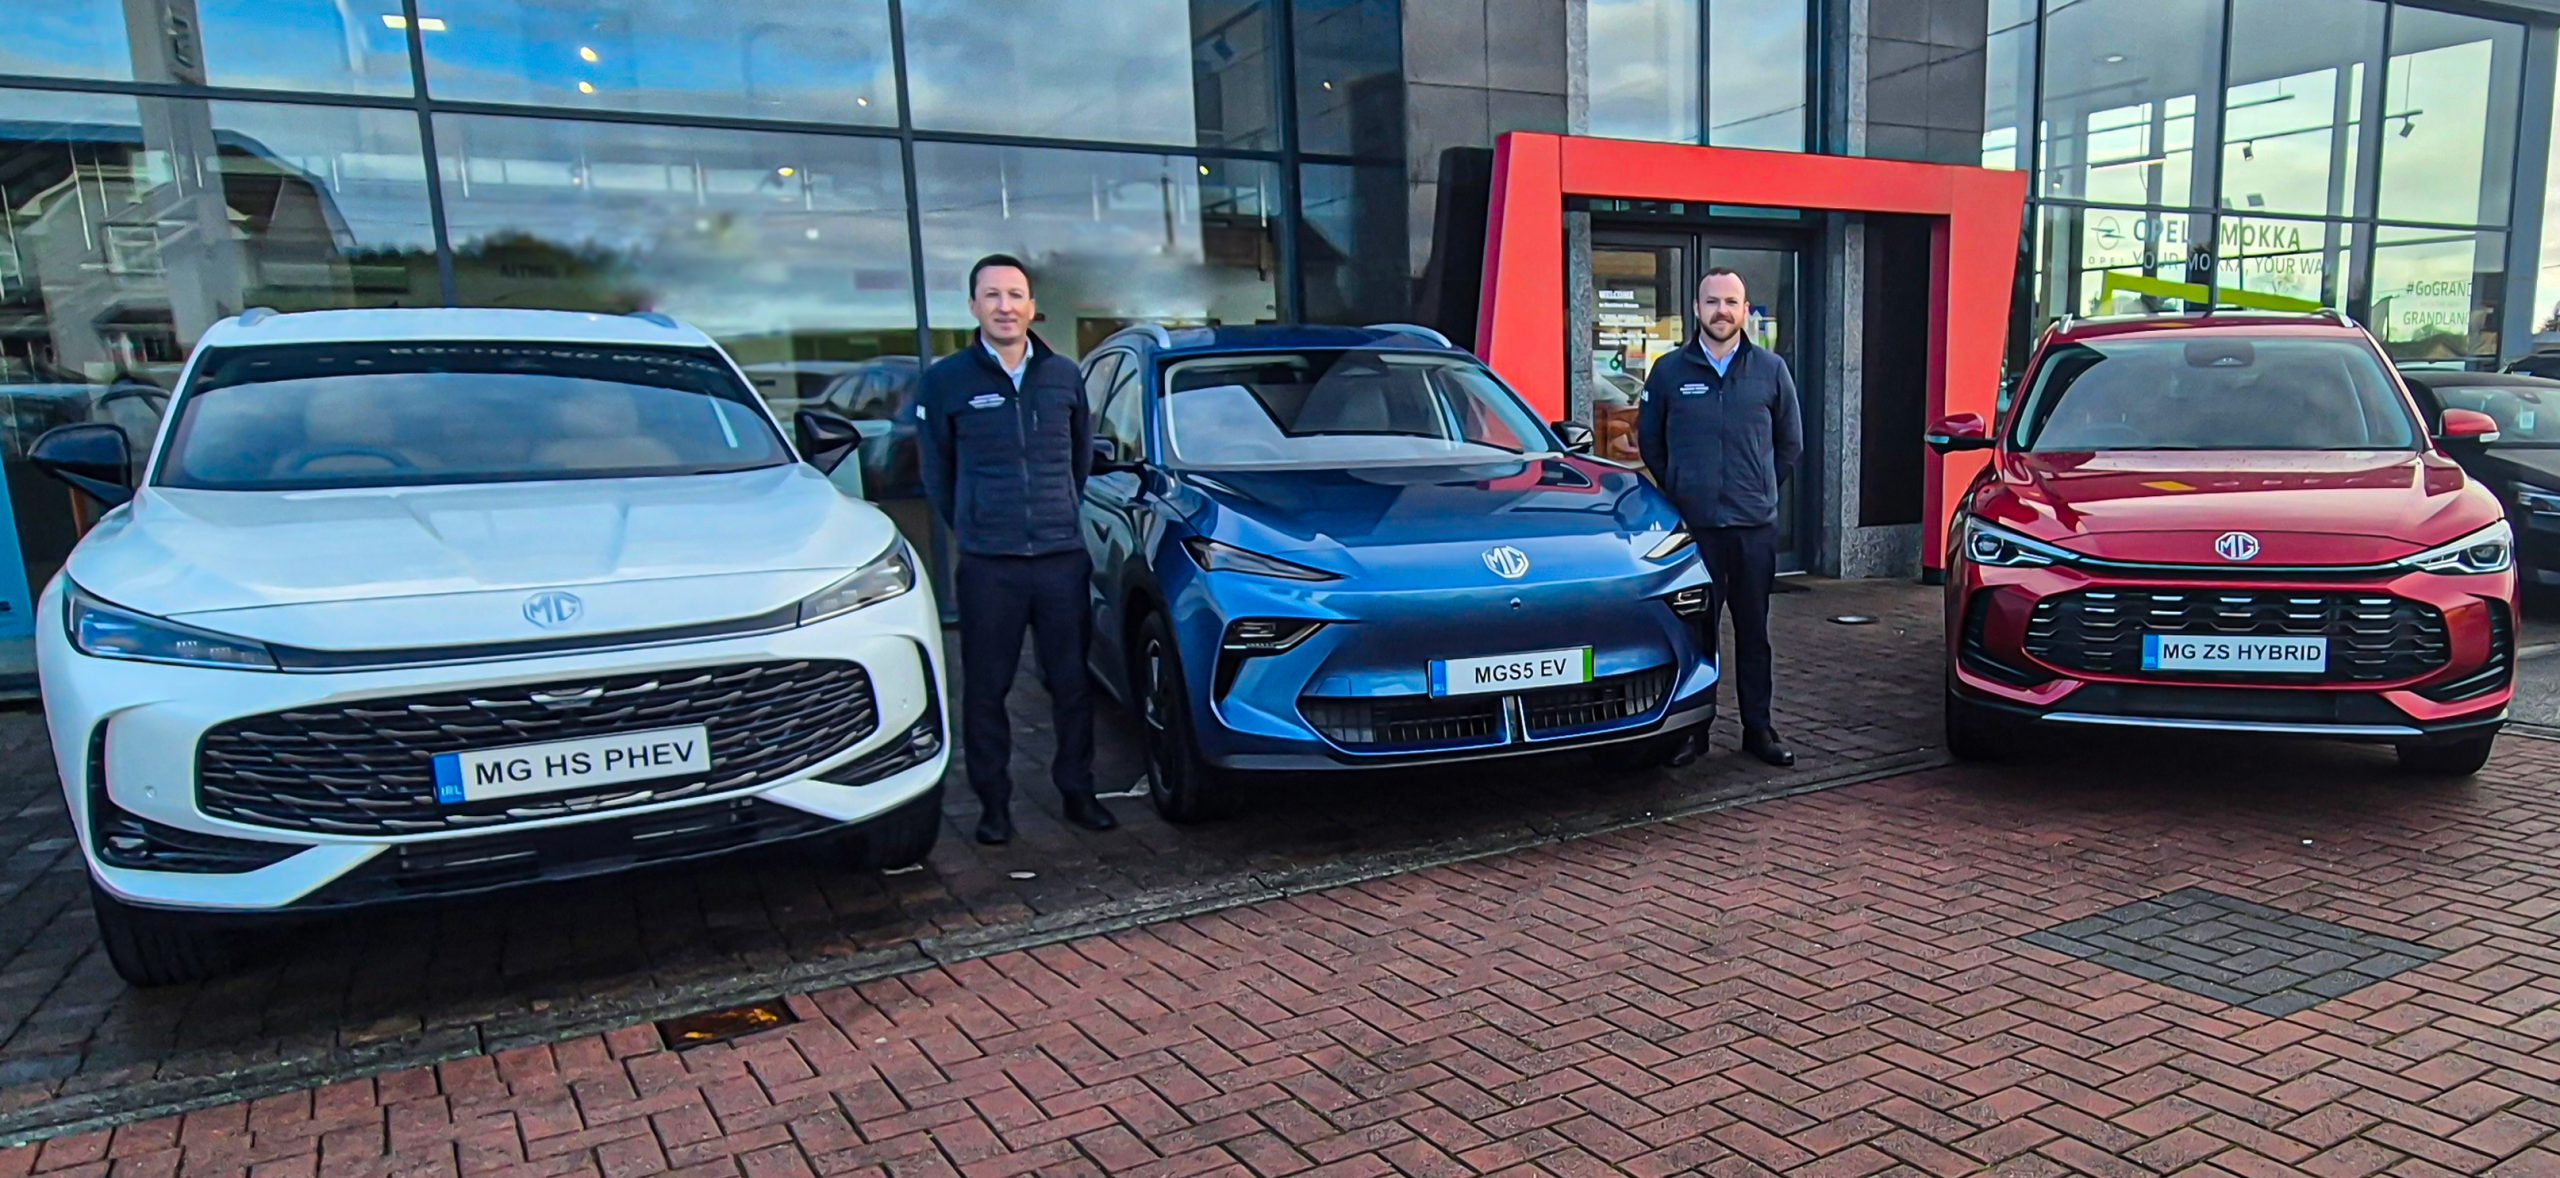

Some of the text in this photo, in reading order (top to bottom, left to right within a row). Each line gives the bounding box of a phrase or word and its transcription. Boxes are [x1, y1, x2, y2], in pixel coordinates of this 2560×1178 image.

[2133, 219, 2302, 248] OPEL MOKKA
[2255, 256, 2295, 275] YOUR
[2217, 533, 2257, 559] MG
[1485, 547, 1526, 576] MG
[526, 593, 580, 625] MG
[2163, 643, 2321, 661] MG ZS HYBRID
[1475, 658, 1567, 684] MGS5 EV
[475, 740, 694, 785] MG HS PHEV
